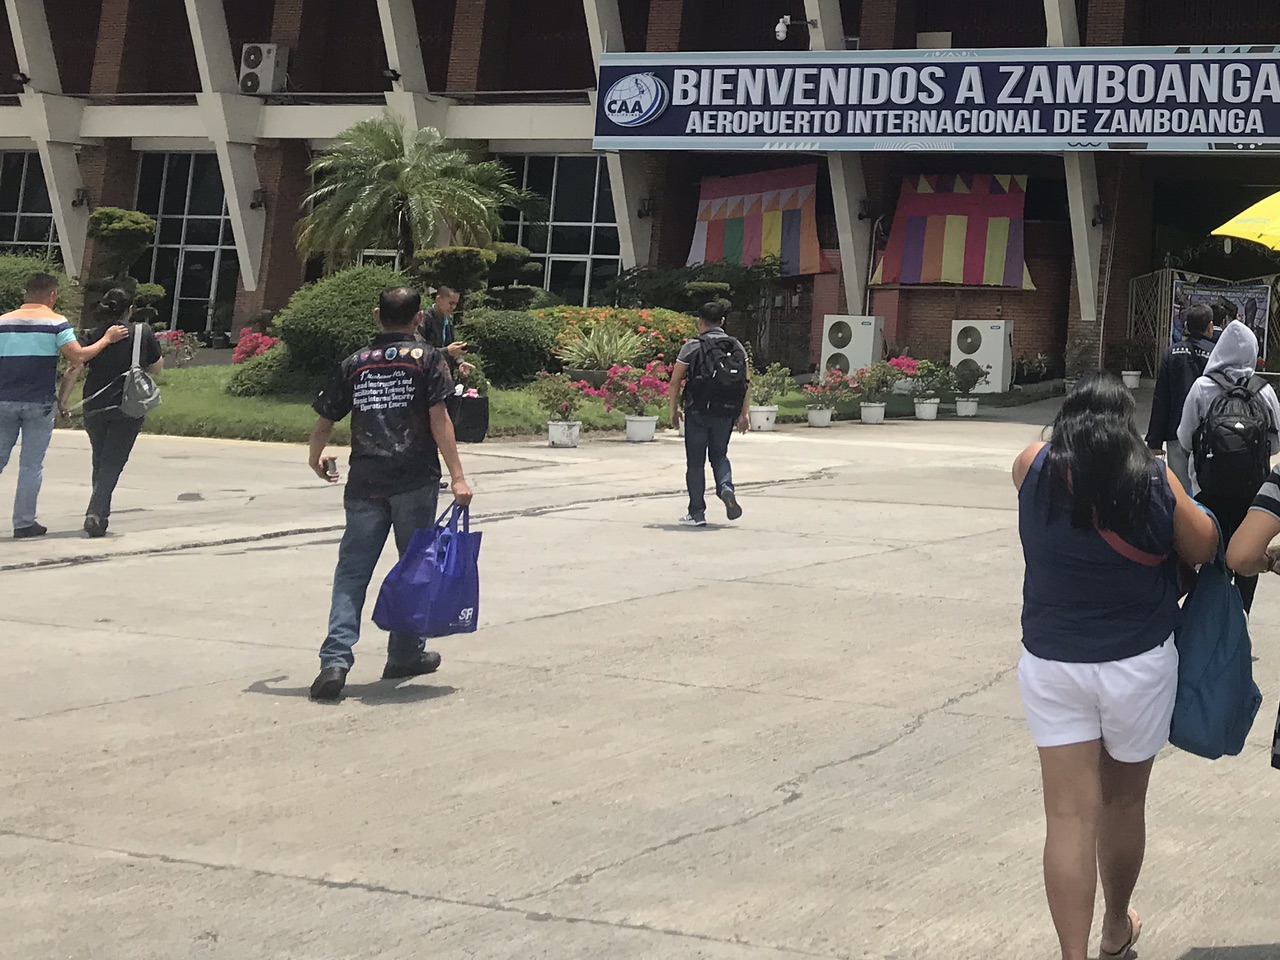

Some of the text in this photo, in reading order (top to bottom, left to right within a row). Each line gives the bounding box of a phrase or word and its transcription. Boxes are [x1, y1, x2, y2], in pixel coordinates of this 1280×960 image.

[672, 65, 946, 106] BIENVENIDOS
[955, 65, 986, 104] A
[607, 100, 643, 114] CAA
[685, 108, 1265, 134] AEROPUERTO INTERNACIONAL DE ZAMBOANGA
